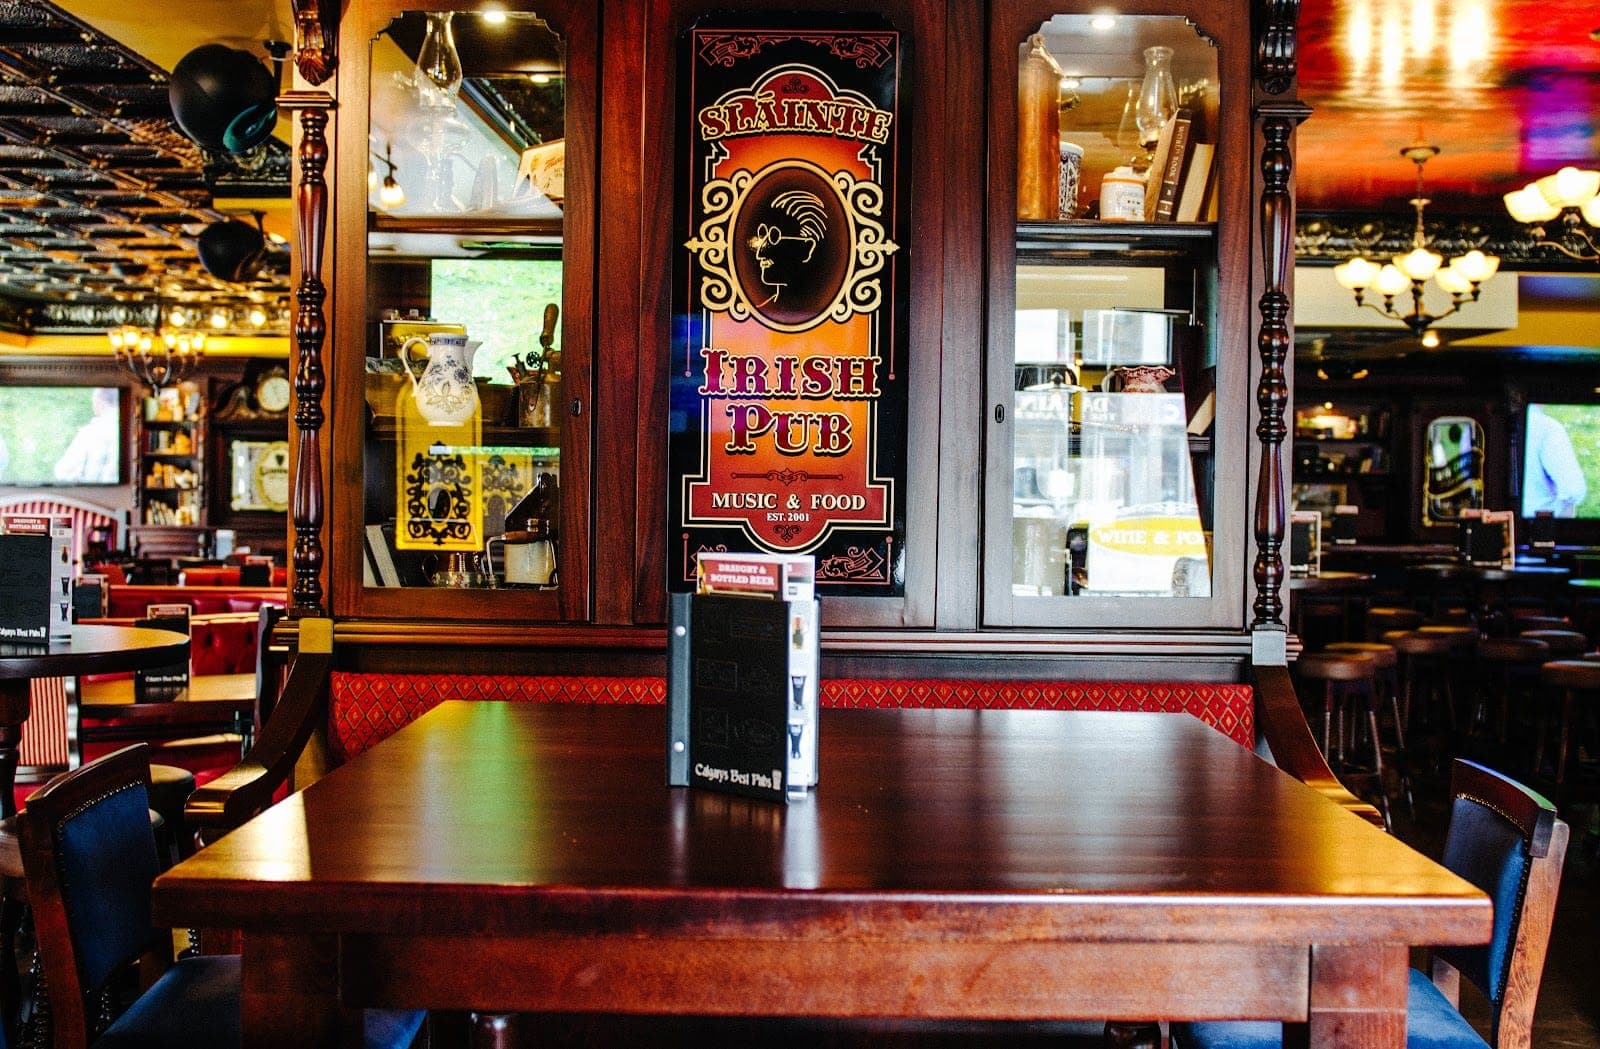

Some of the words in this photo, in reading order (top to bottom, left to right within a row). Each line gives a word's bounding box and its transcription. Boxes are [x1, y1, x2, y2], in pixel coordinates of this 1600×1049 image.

[698, 91, 893, 145] SLÁINTE
[698, 347, 882, 398] IRISH
[726, 403, 852, 454] PUB
[711, 492, 777, 509] MUSIC
[786, 493, 800, 510] &
[810, 494, 866, 510] FOOD
[766, 512, 786, 522] EST.
[787, 513, 810, 522] 2001
[710, 573, 748, 585] BOTTLED
[749, 575, 775, 587] BEER
